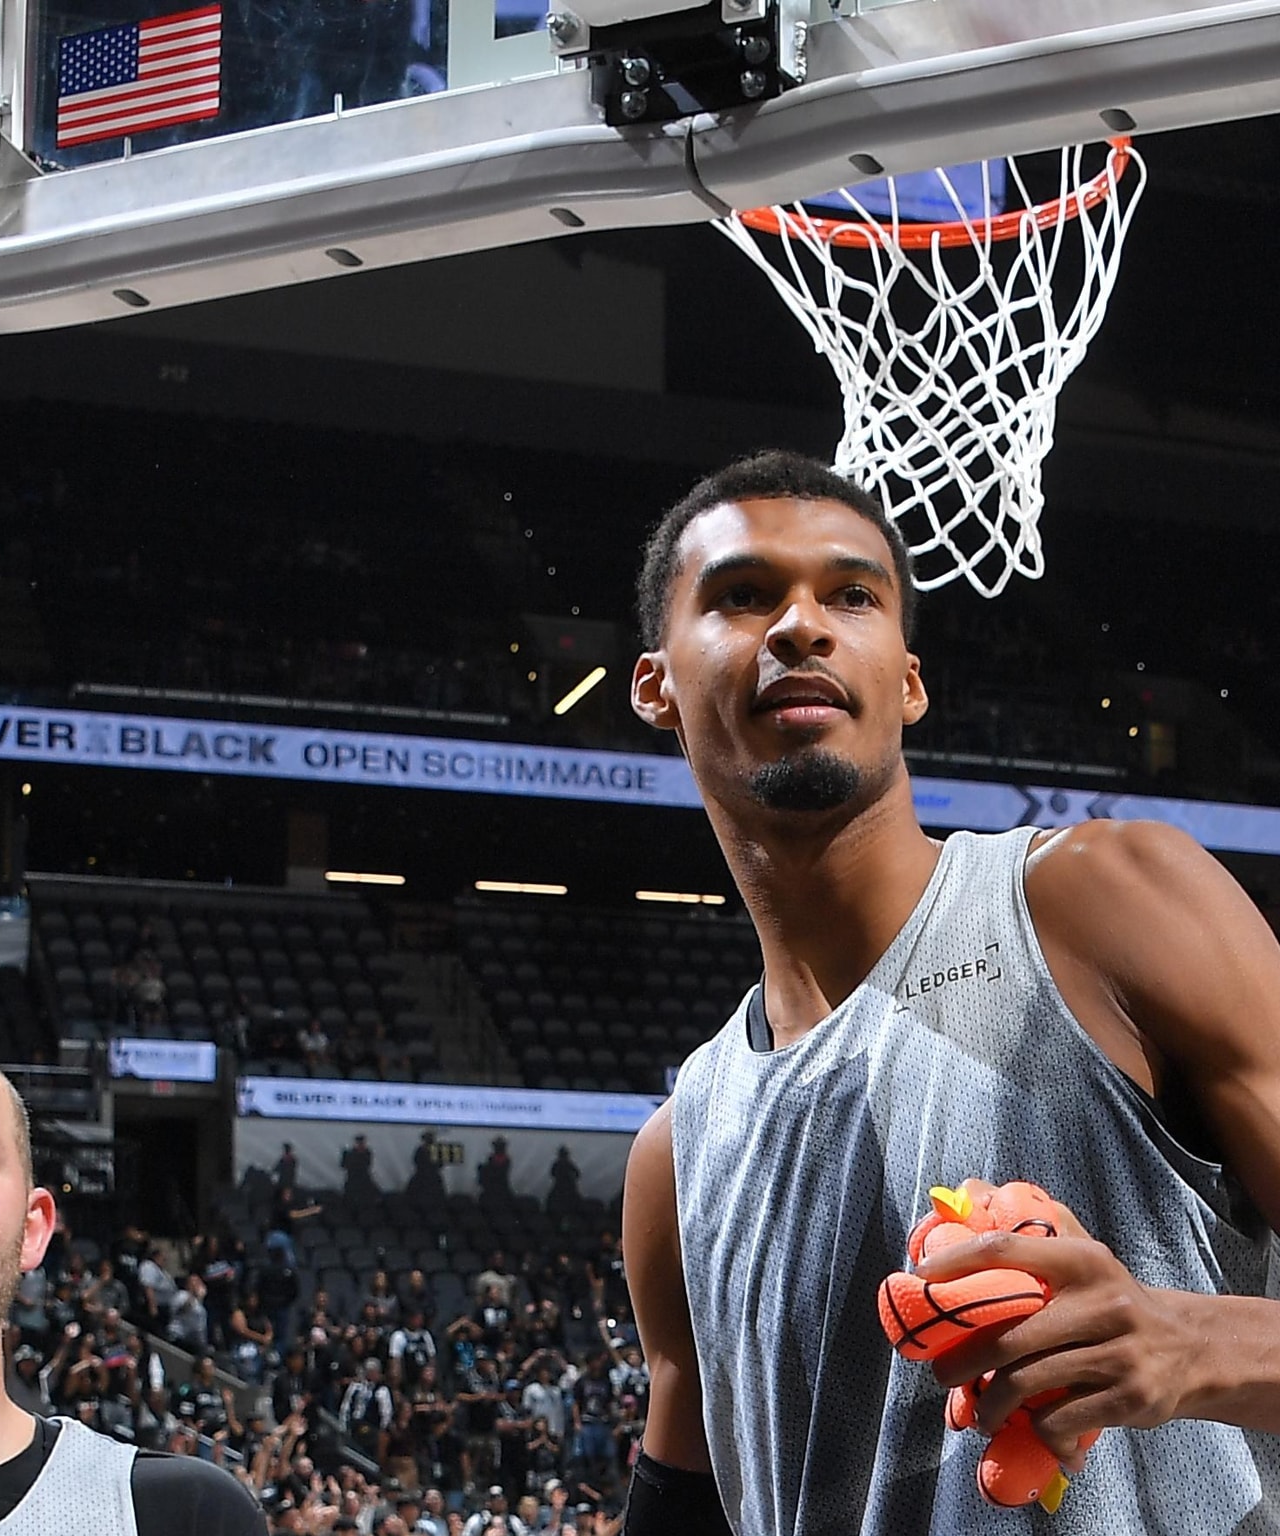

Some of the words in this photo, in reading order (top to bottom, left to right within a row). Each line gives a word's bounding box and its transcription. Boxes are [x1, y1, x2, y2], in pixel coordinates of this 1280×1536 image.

[119, 726, 277, 765] BLACK
[303, 742, 410, 775] OPEN
[423, 747, 658, 792] SCRIMMAGE
[905, 958, 988, 1000] LEDGER
